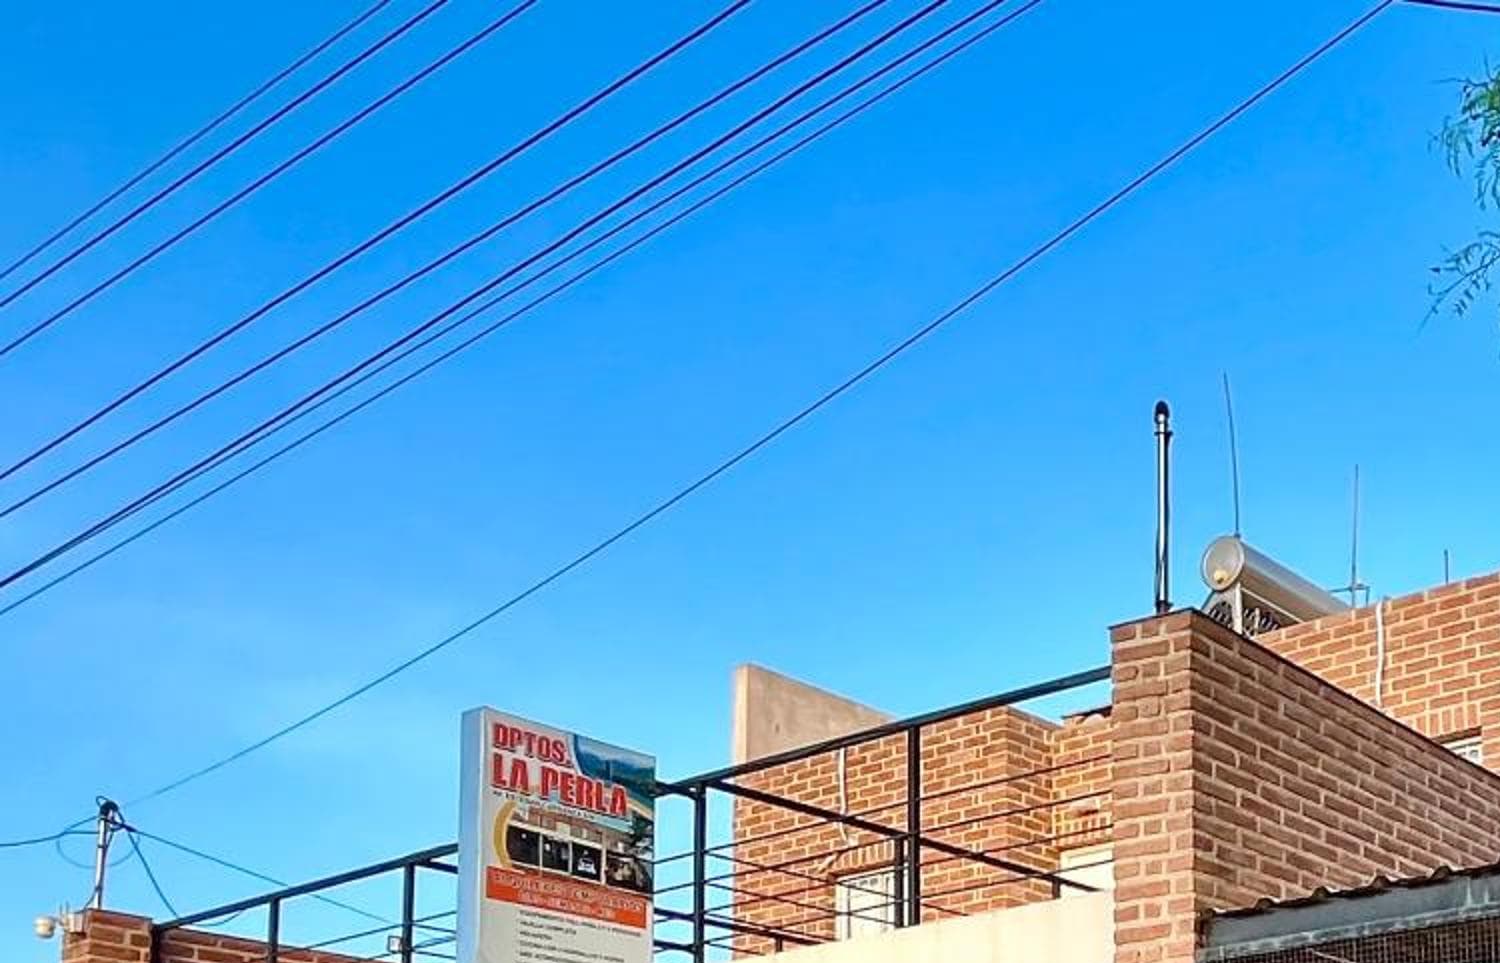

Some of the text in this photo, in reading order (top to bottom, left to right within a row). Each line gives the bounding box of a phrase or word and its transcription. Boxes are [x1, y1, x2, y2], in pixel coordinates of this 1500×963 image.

[493, 722, 574, 768] DPTOS.
[492, 752, 530, 796] LA
[540, 766, 627, 818] PERLA
